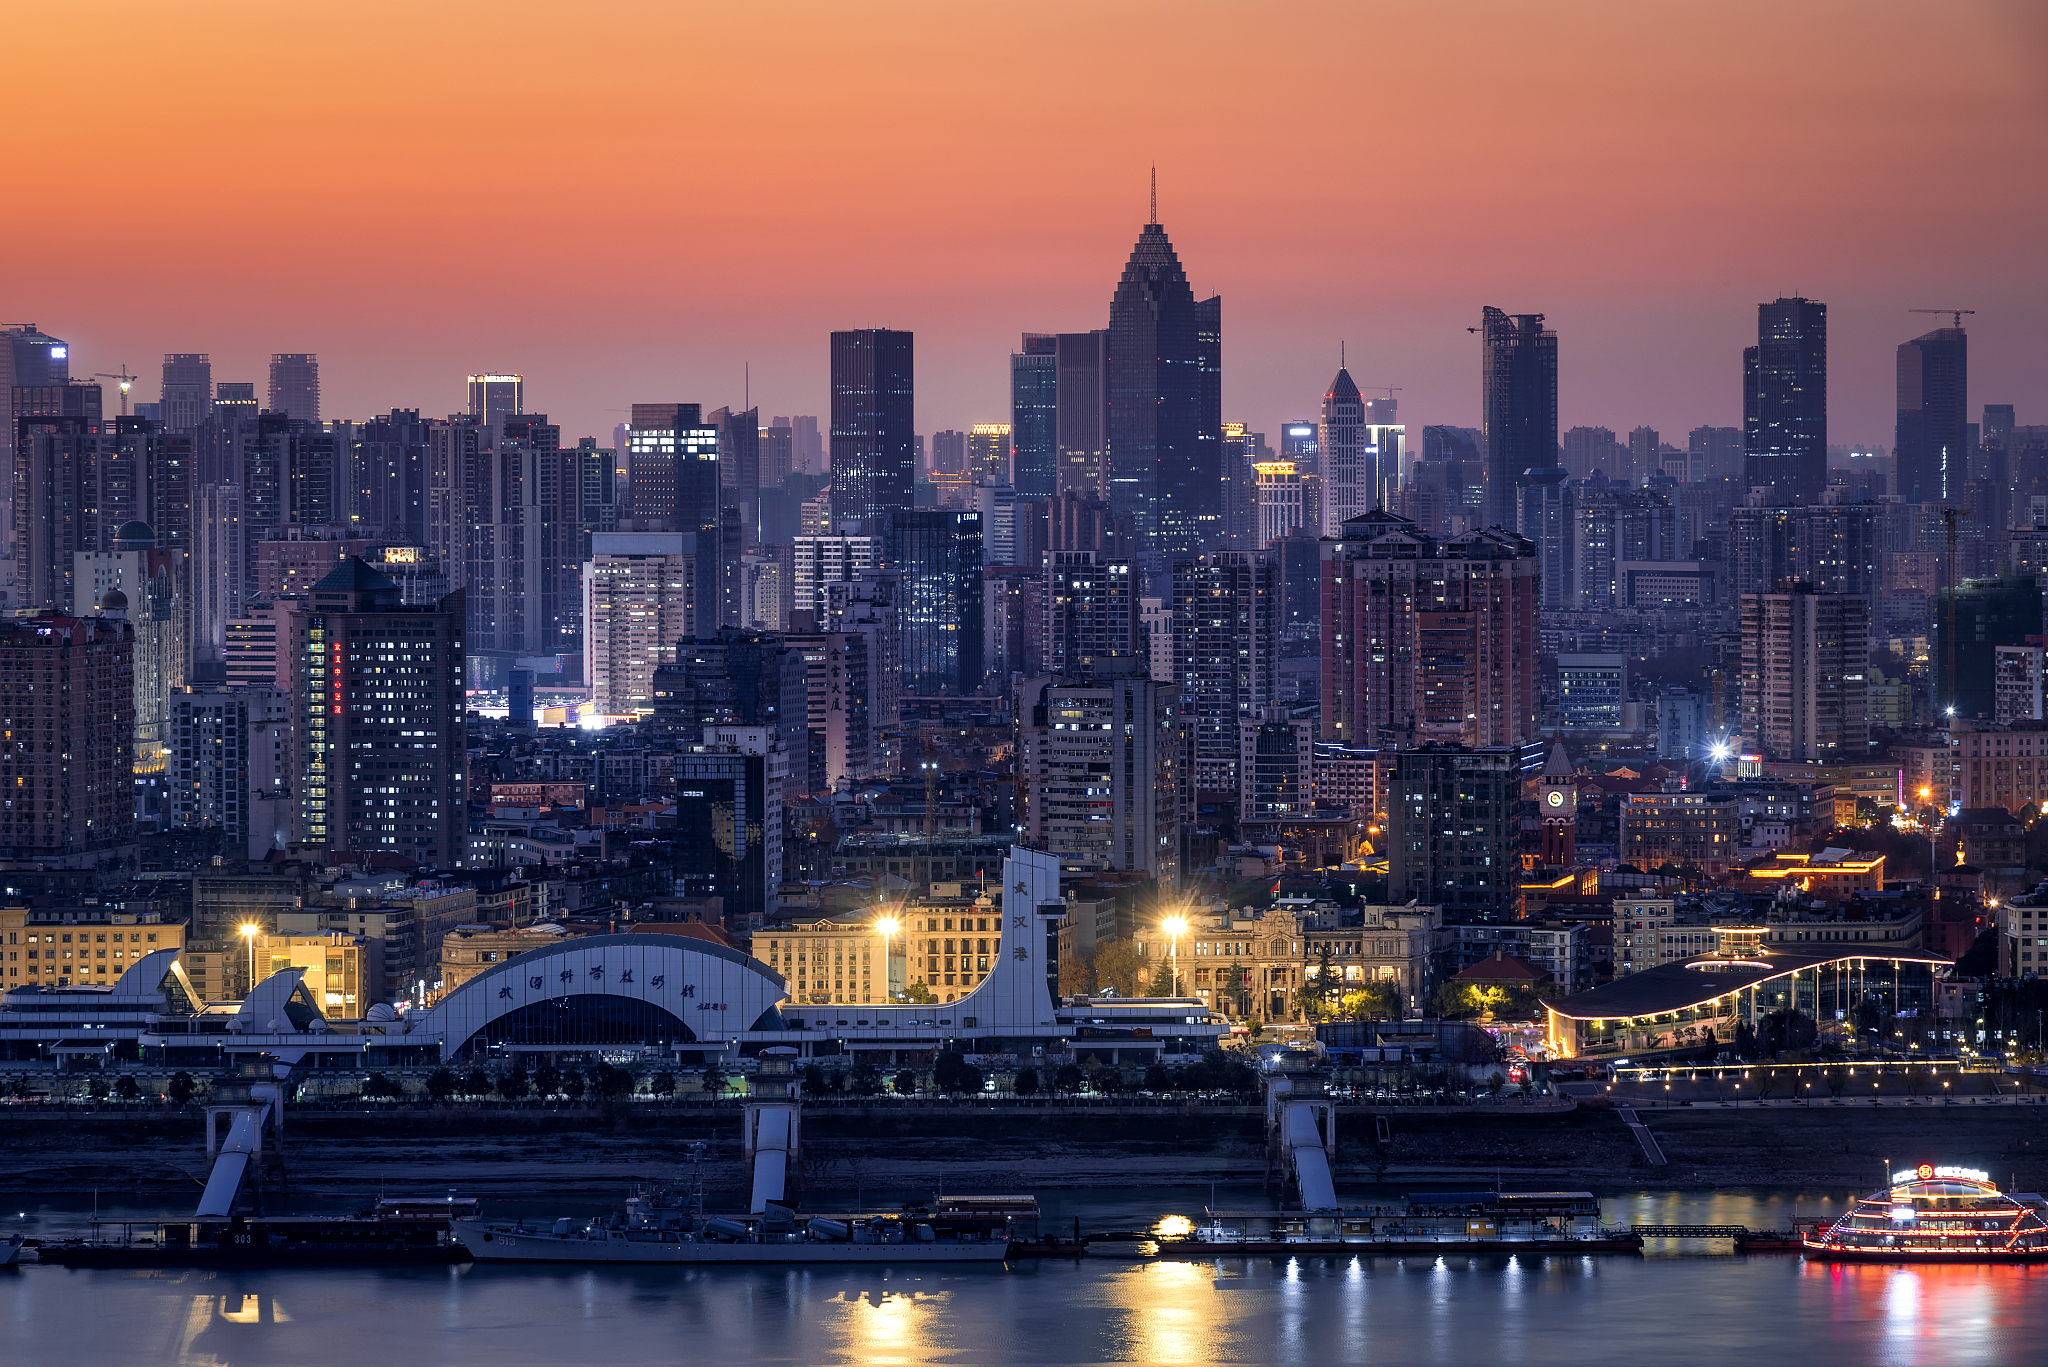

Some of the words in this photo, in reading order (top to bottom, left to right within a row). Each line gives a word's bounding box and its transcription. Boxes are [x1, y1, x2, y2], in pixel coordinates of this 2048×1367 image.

[1013, 881, 1028, 961] 武汉港
[234, 1234, 251, 1244] 303
[498, 1236, 516, 1247] 513
